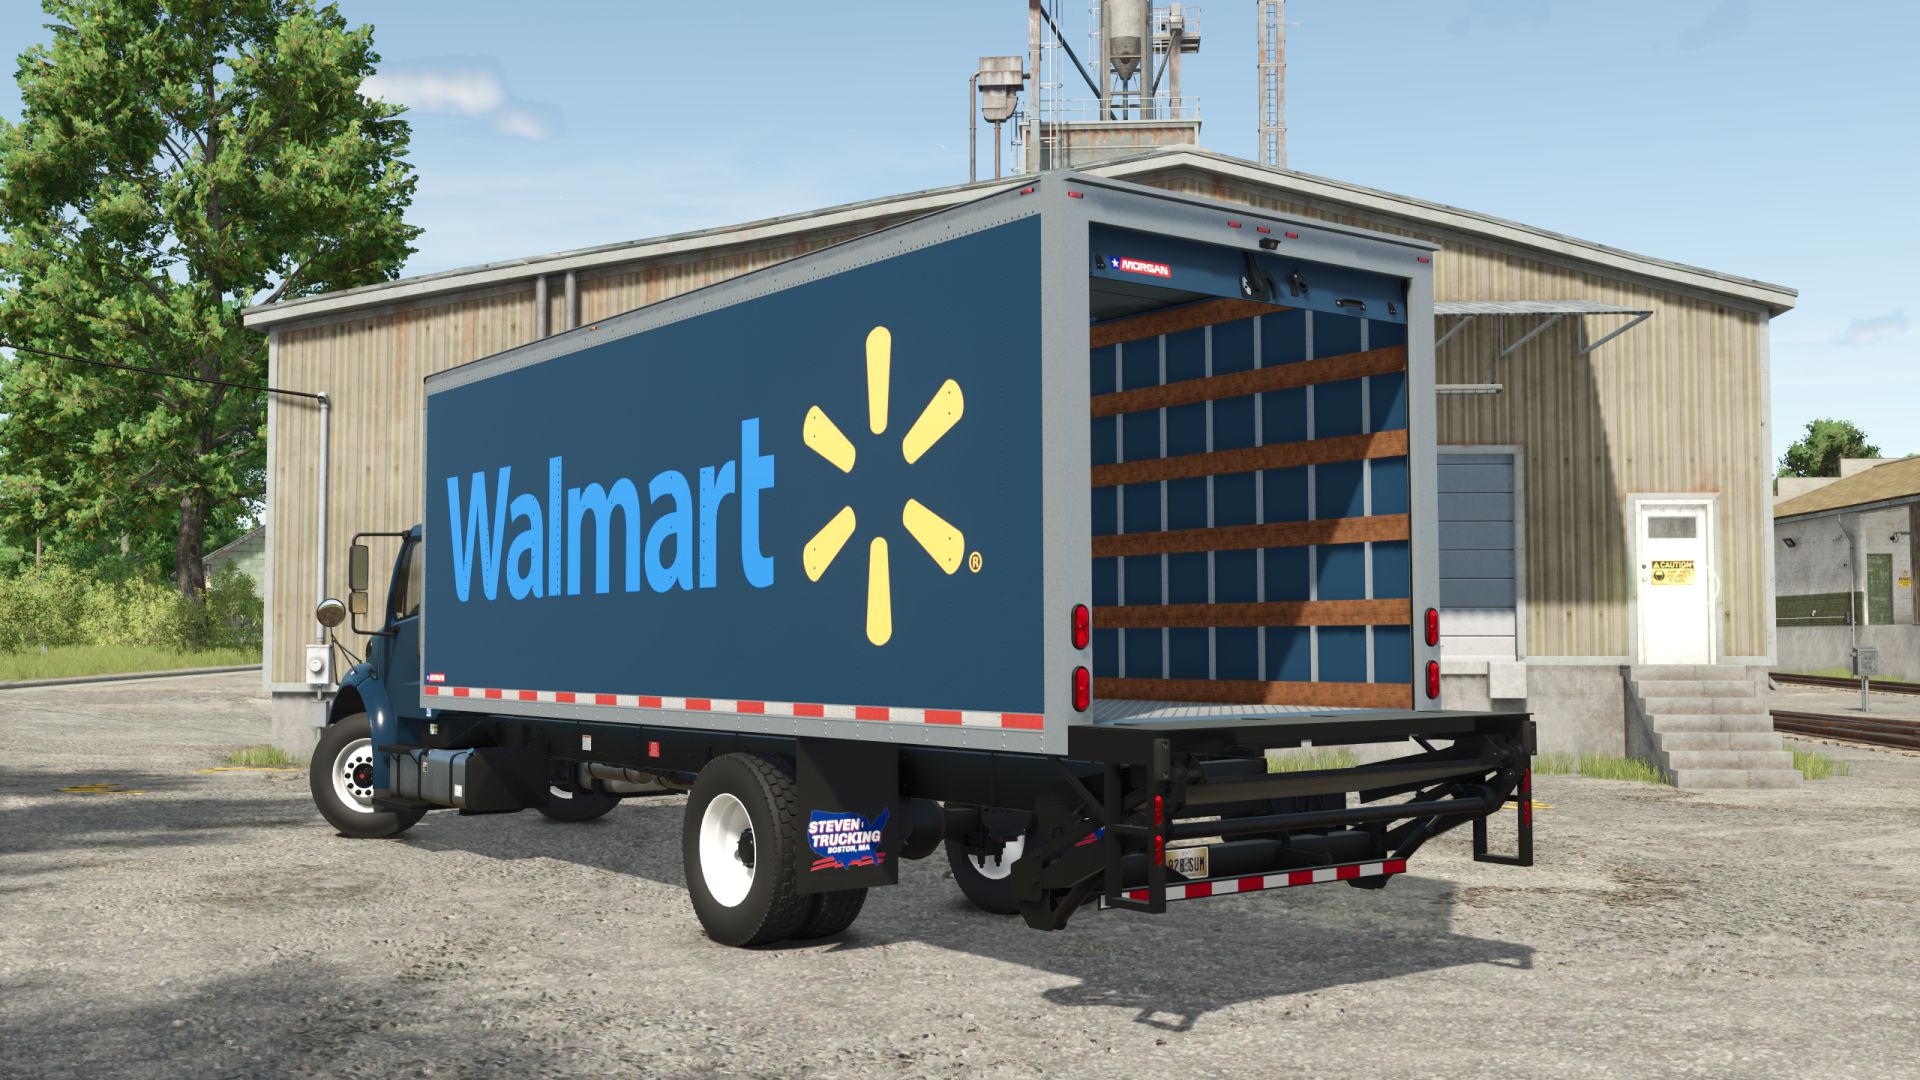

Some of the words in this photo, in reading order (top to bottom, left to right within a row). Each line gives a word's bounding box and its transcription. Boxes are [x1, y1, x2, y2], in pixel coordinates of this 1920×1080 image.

[1121, 259, 1169, 276] MORGAN
[447, 417, 775, 602] Walmart
[1660, 561, 1692, 569] CAUTION
[808, 818, 864, 834] STEVEN
[812, 830, 881, 848] TRUCKING
[827, 845, 858, 854] BOSTON,
